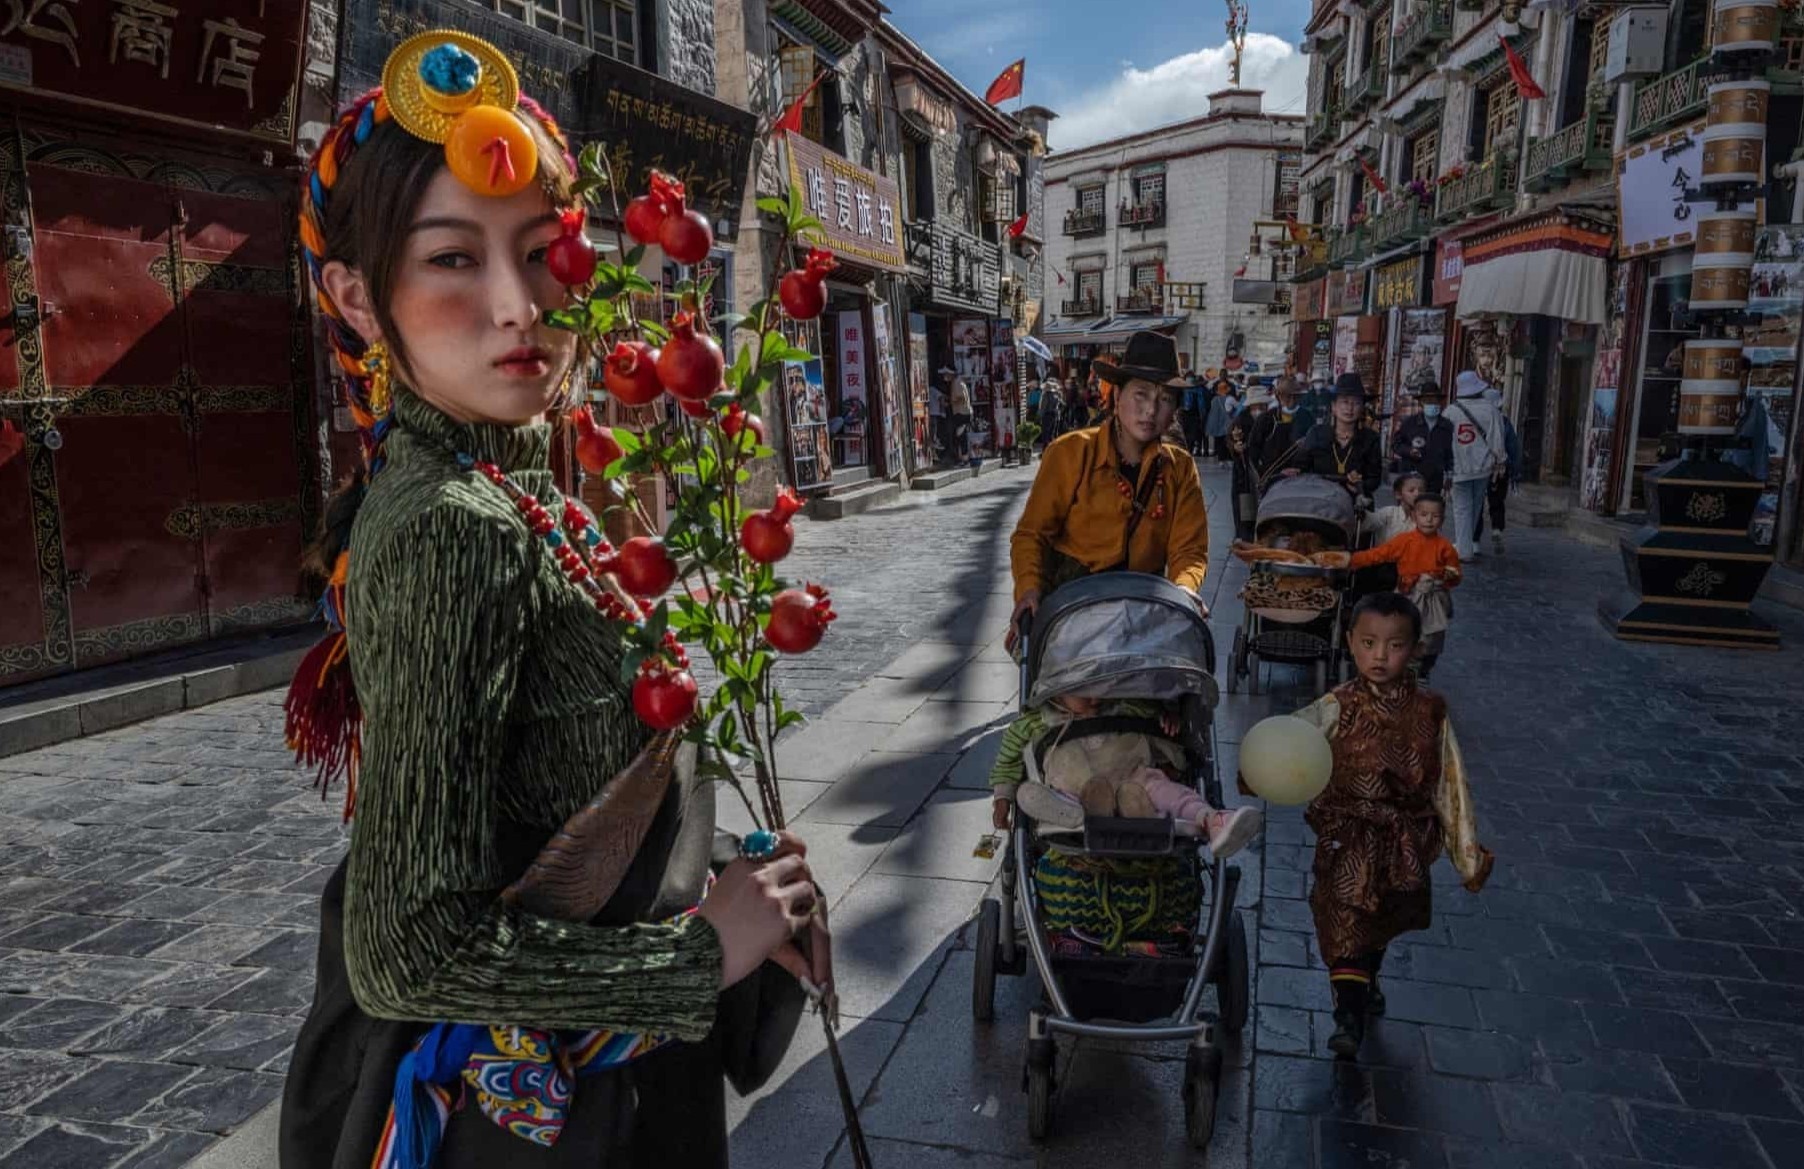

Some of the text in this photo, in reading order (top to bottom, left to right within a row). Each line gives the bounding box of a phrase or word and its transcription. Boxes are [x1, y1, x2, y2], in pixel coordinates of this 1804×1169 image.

[806, 166, 895, 246] 唯爱旅拍
[1458, 424, 1475, 445] 5
